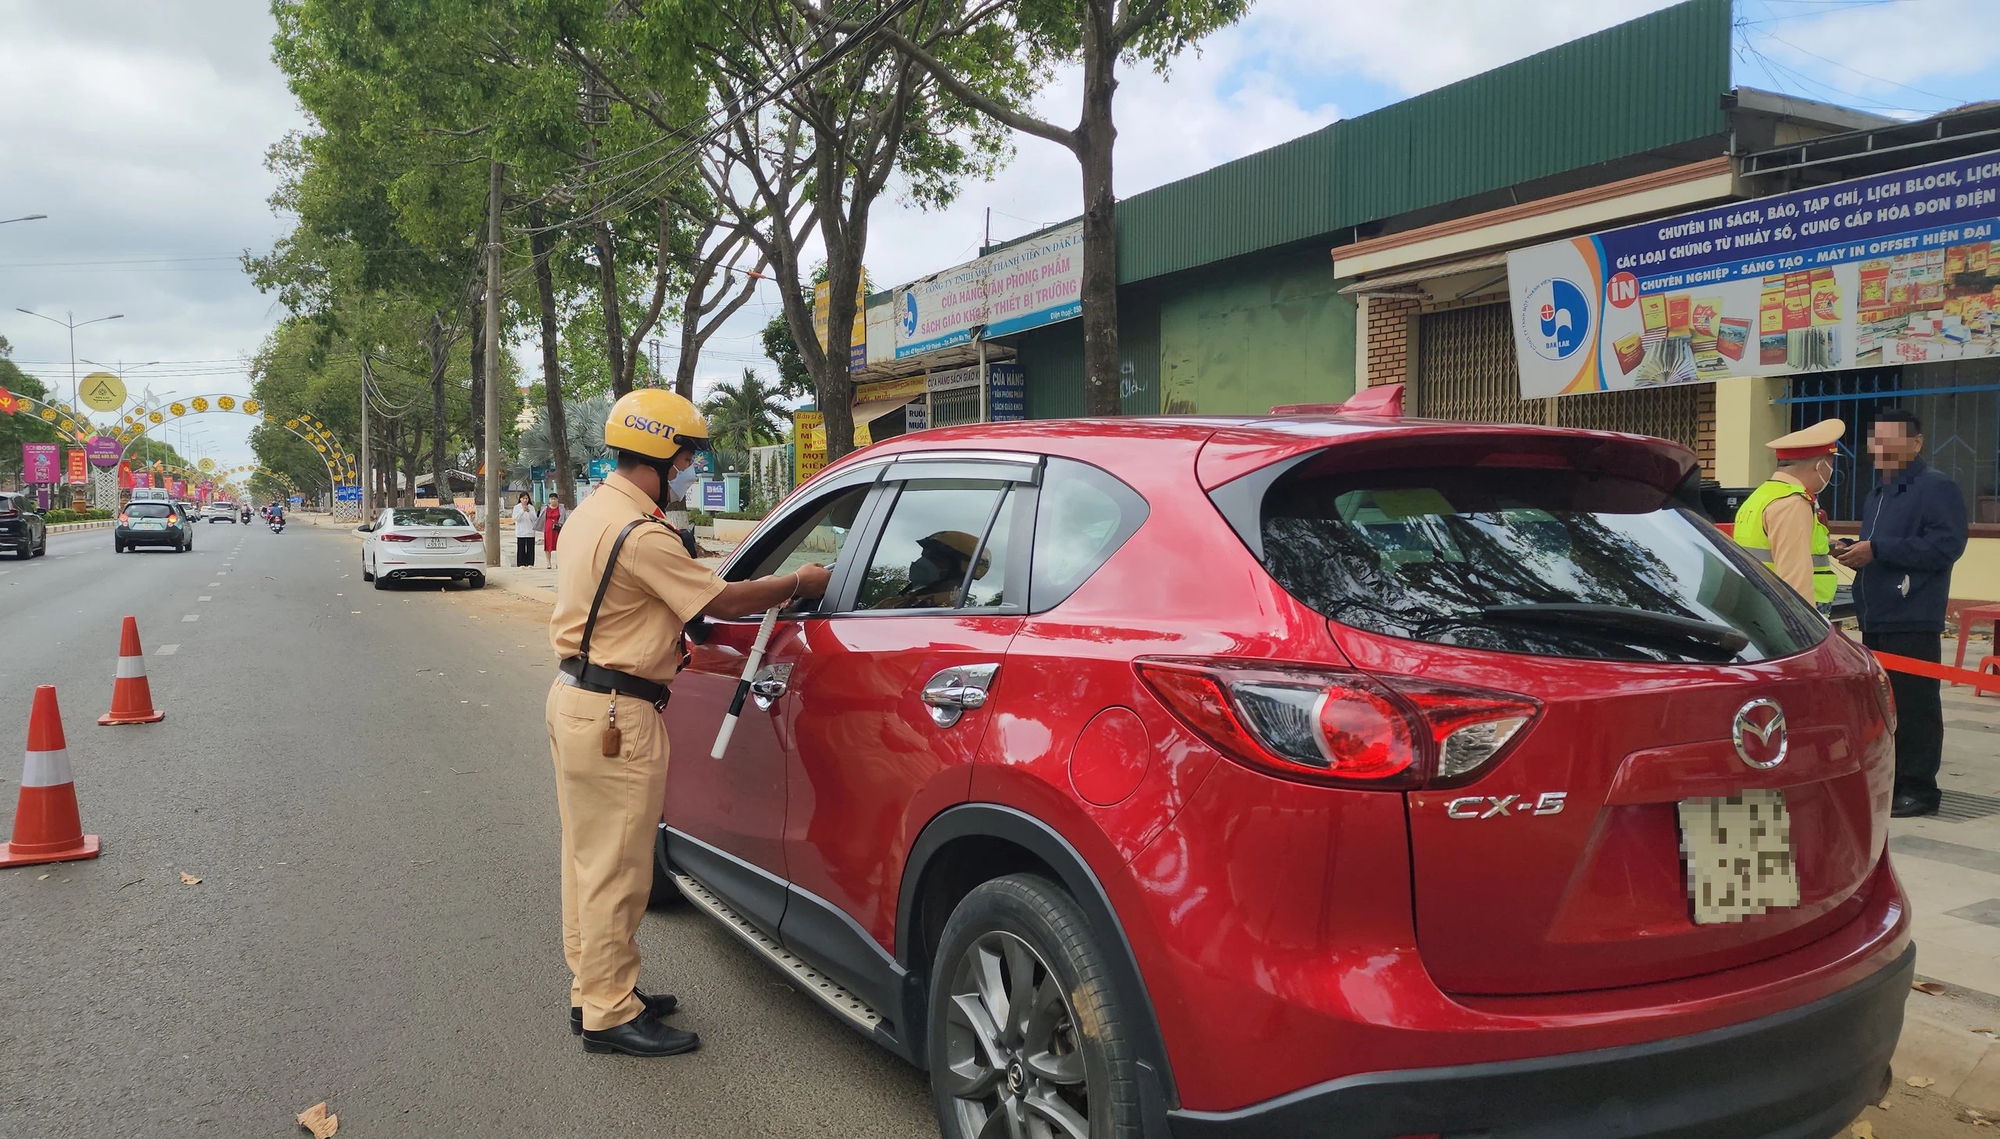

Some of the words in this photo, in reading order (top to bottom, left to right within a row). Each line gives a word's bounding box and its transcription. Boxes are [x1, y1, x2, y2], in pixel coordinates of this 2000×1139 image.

[1616, 253, 1637, 269] CÁC
[1640, 248, 1666, 265] LOẠI
[1669, 241, 1712, 260] CHỨNG
[1715, 235, 1731, 250] TỪ
[1774, 222, 1797, 241] SỐ,
[1800, 218, 1841, 236] CUNG
[1844, 207, 1873, 228] CẤP
[1877, 203, 1911, 223] HÓA
[1914, 196, 1950, 216] ĐƠN
[1955, 188, 1996, 209] ĐIỆN
[1658, 220, 1705, 241] CHUYÊN
[1708, 216, 1723, 231] IN
[1726, 211, 1764, 227] SÁCH,
[1767, 203, 1800, 221] BÁO,
[1803, 196, 1830, 214] TẠP
[1833, 188, 1863, 206] CHÍ,
[1867, 182, 1900, 203] LỊCH
[1905, 171, 1962, 194] BLOCK,
[1640, 276, 1682, 292] CHUYÊN
[1685, 267, 1729, 284] NGHIỆP
[1741, 261, 1775, 275] SÁNG
[1778, 255, 1804, 270] TẠO
[1816, 249, 1846, 263] MÁY
[1849, 245, 1865, 257] IN
[1869, 236, 1918, 254] OFFSET
[1922, 228, 1959, 247] HIỆN
[1963, 224, 1991, 240] ĐẠI
[624, 414, 675, 440] CSGT
[1446, 791, 1568, 820] CX-5
